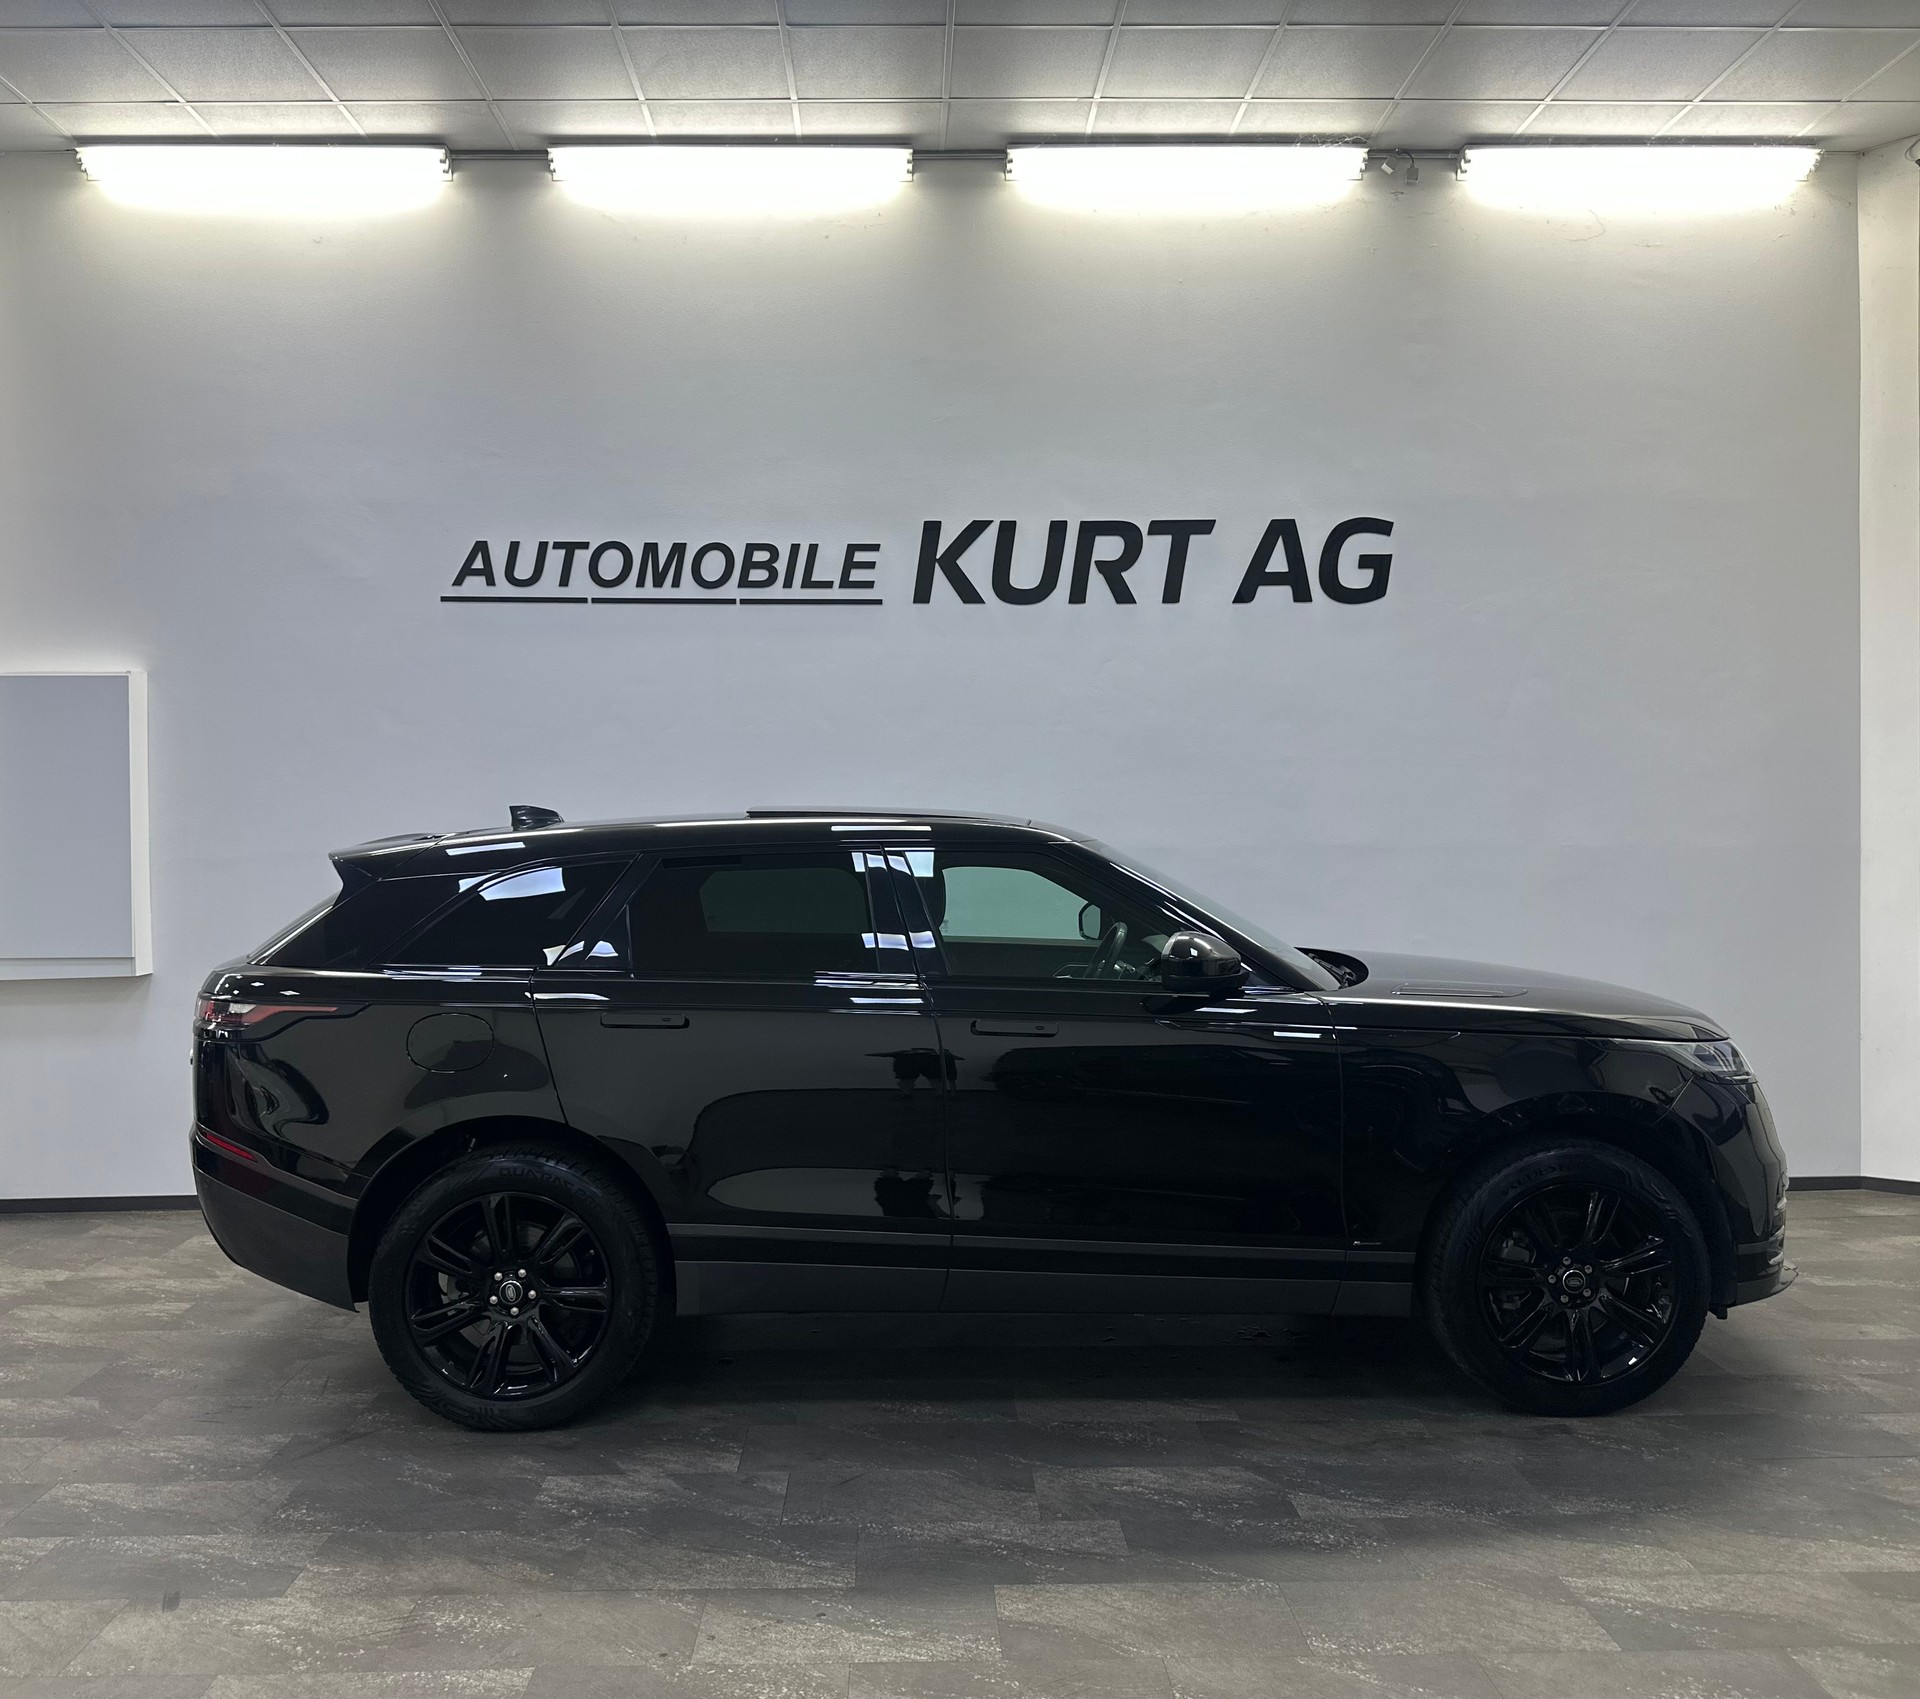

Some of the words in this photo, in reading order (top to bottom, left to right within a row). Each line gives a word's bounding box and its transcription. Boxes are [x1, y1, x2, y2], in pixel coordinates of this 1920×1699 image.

[452, 541, 881, 589] AUTOMOBILE
[913, 520, 1217, 606] KURT
[1232, 517, 1395, 605] AG
